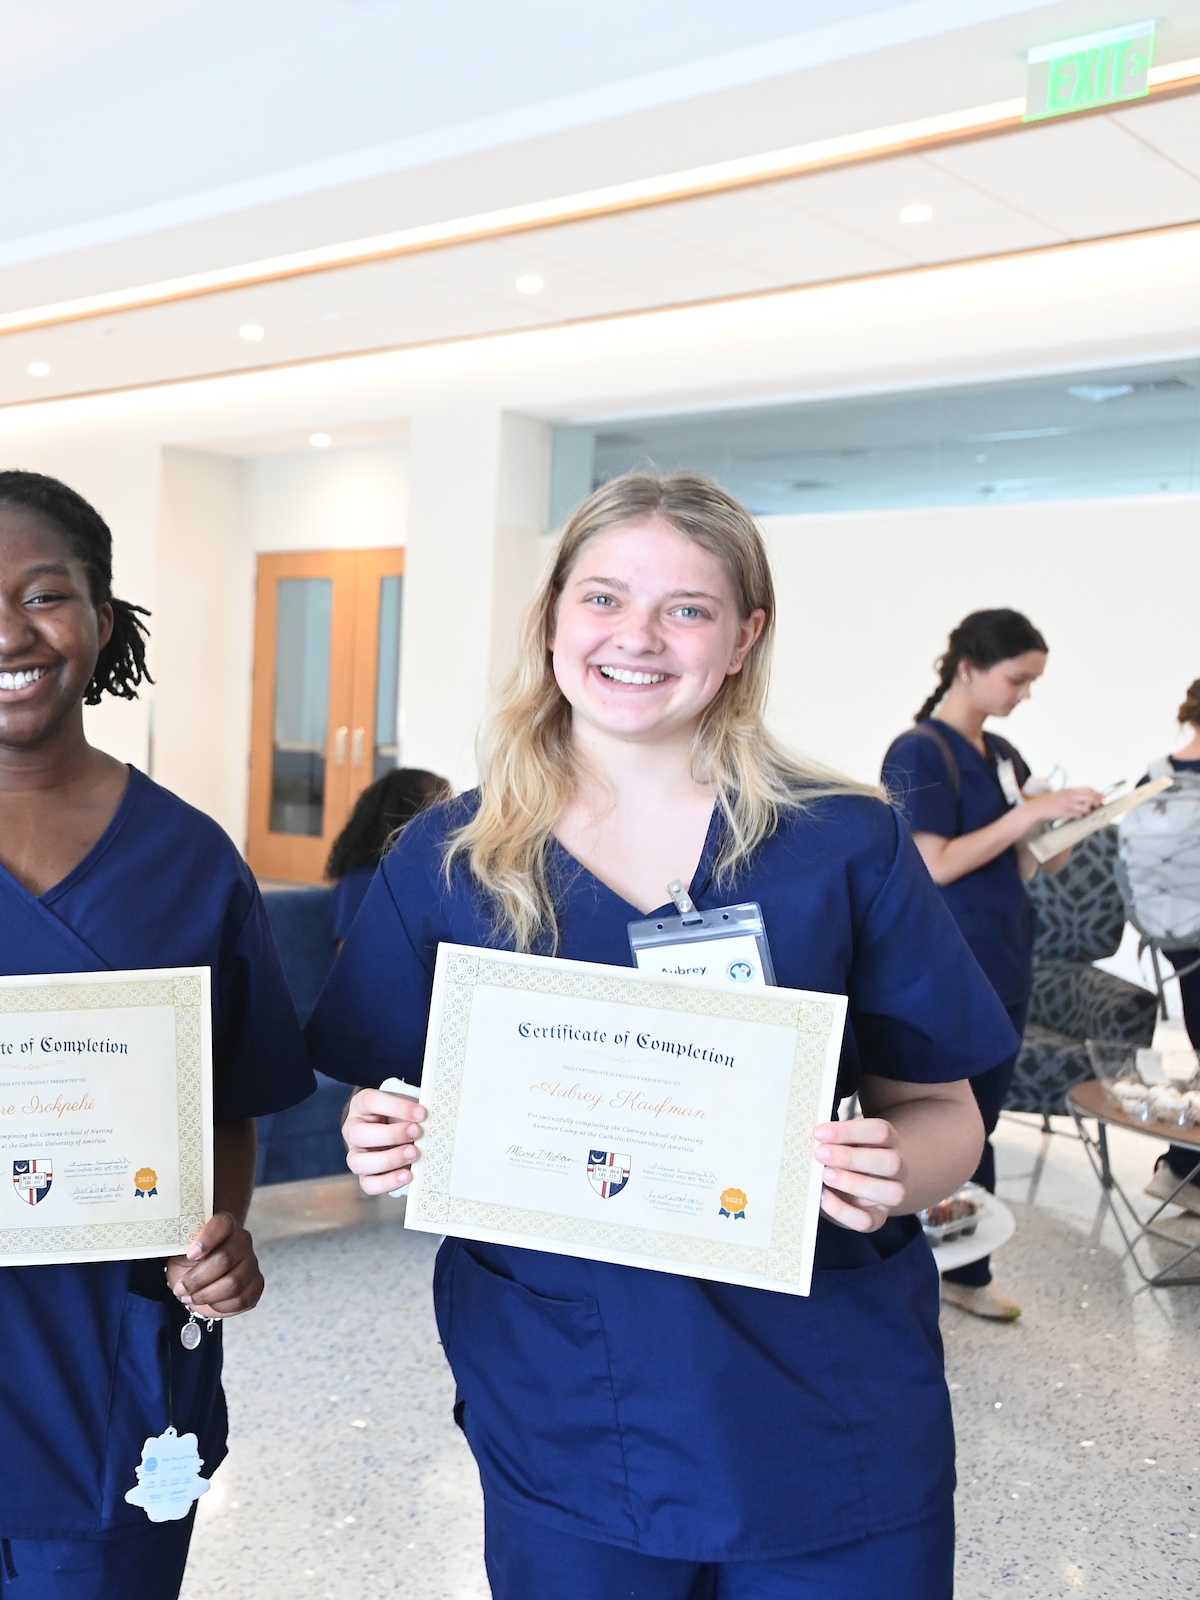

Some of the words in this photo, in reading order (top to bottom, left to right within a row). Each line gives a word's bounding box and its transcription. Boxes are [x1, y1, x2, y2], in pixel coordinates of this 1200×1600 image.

[1047, 39, 1133, 110] EXIT
[20, 1037, 34, 1054] of
[40, 1037, 128, 1054] Completion
[518, 1022, 607, 1043] Certificate
[614, 1030, 631, 1046] of
[636, 1033, 734, 1068] Completion
[21, 1092, 95, 1119] Isokpehi
[530, 1081, 603, 1112] Aubrey
[609, 1091, 708, 1119] Kaufman
[533, 1122, 558, 1131] Summer
[559, 1127, 579, 1136] Camp
[598, 1133, 624, 1142] Catholic
[626, 1137, 659, 1148] University
[539, 1115, 575, 1125] successfully
[575, 1121, 610, 1131] completing
[622, 1126, 648, 1137] Conway
[648, 1131, 670, 1139] School
[677, 1135, 704, 1145] Nursing
[19, 1141, 44, 1149] Catholic
[138, 1175, 154, 1184] 2025
[725, 1195, 743, 1205] 2025
